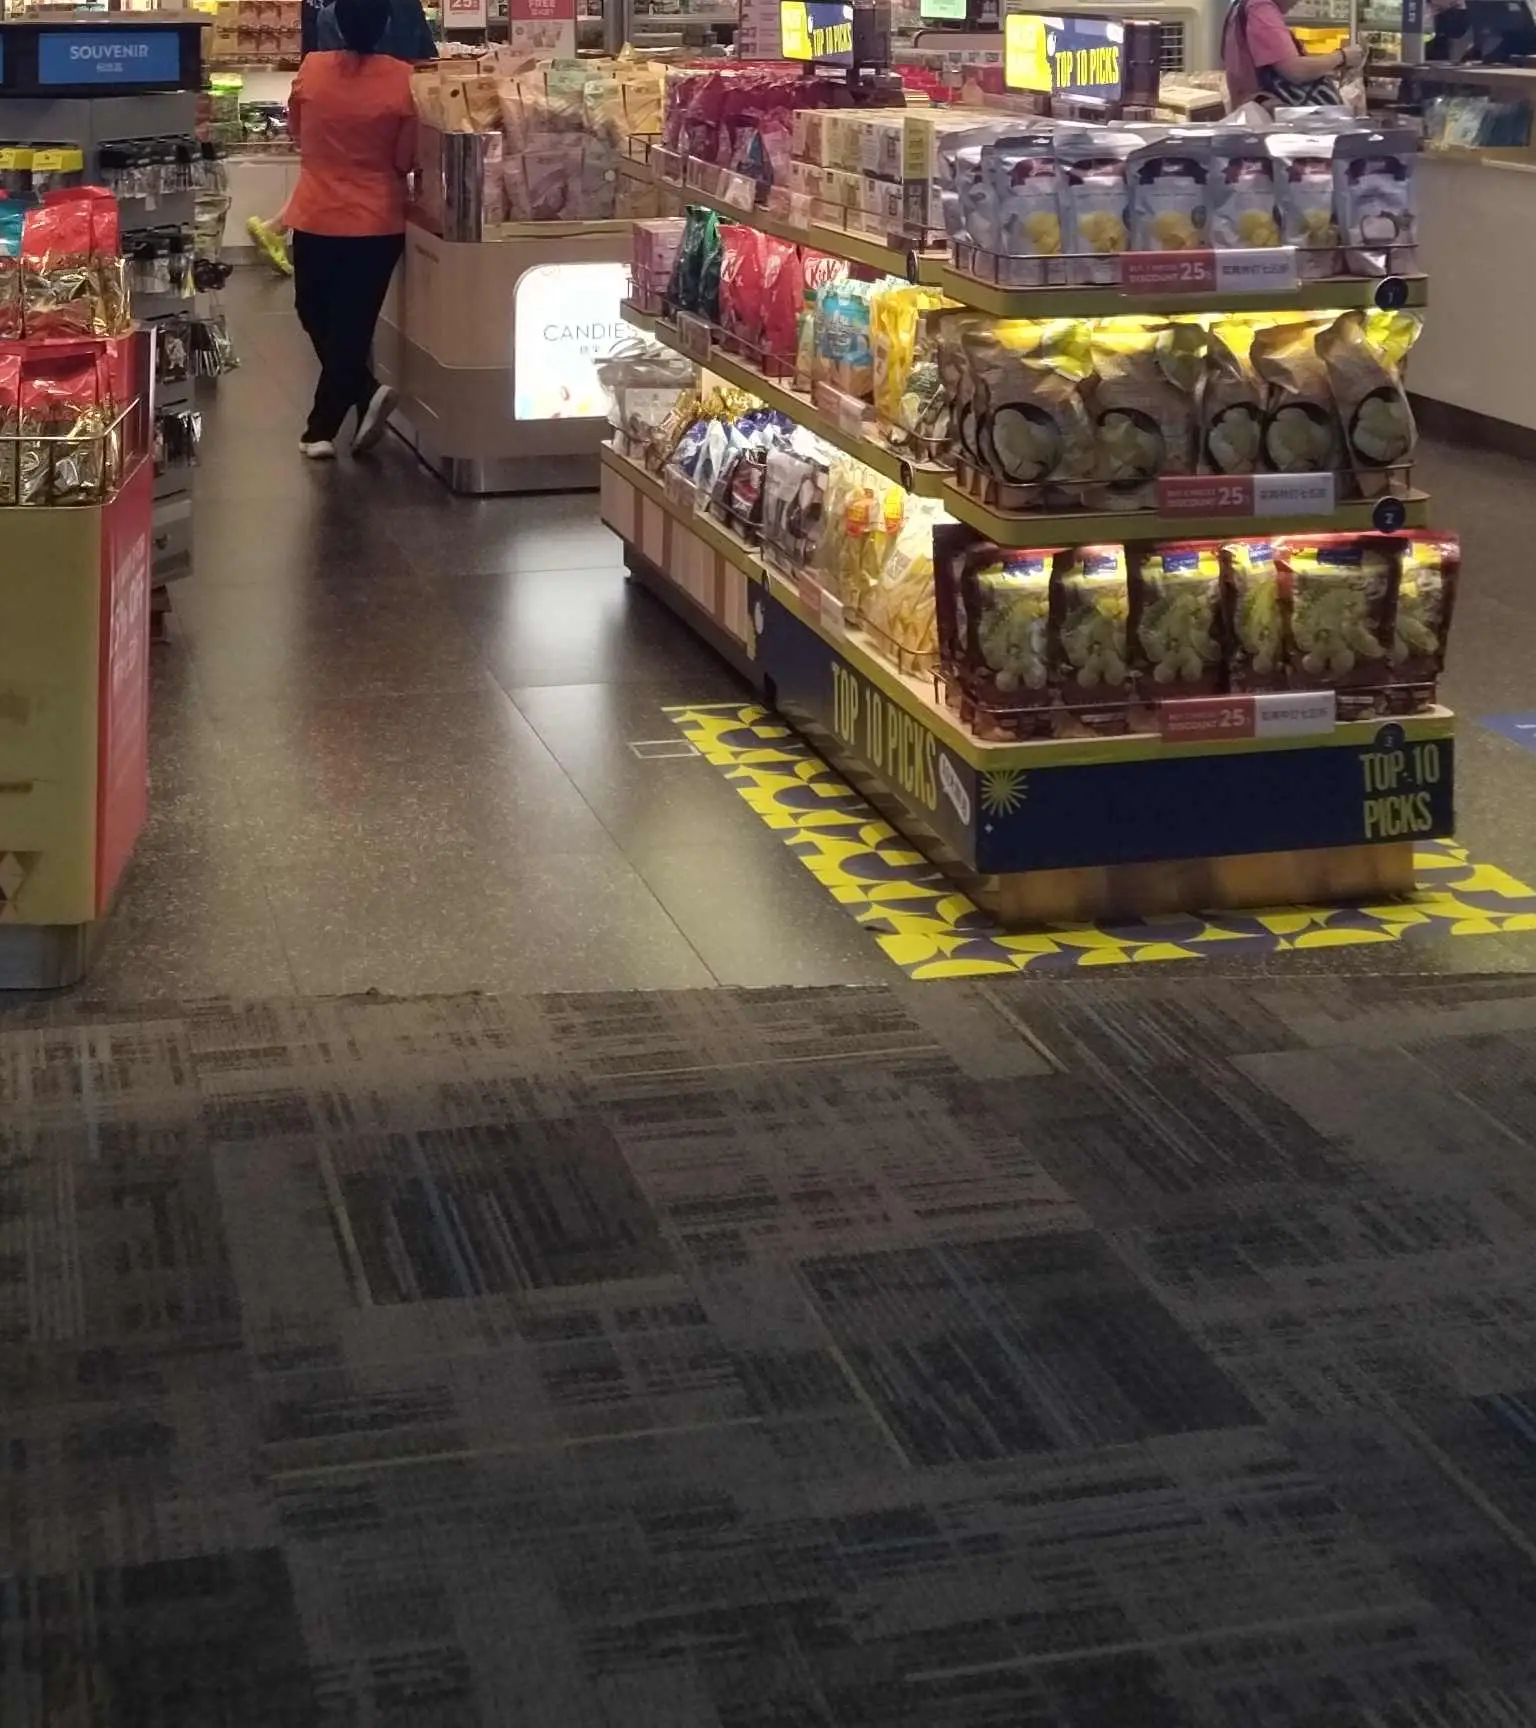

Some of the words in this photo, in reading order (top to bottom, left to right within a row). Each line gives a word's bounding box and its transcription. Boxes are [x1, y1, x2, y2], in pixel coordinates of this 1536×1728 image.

[528, 0, 556, 8] FREE
[70, 44, 150, 60] SOUVENIR
[813, 28, 825, 57] TOP
[826, 26, 833, 55] 10
[834, 22, 853, 54] PICKS
[1055, 50, 1073, 88] TOP
[1076, 49, 1088, 86] 10
[1089, 45, 1119, 86] PICKS
[831, 661, 859, 745] TOP
[866, 686, 883, 768] 10
[887, 702, 937, 811] PICKS
[1359, 750, 1405, 792] TOP
[1414, 743, 1440, 784] 10
[1364, 792, 1433, 839] PICKS
